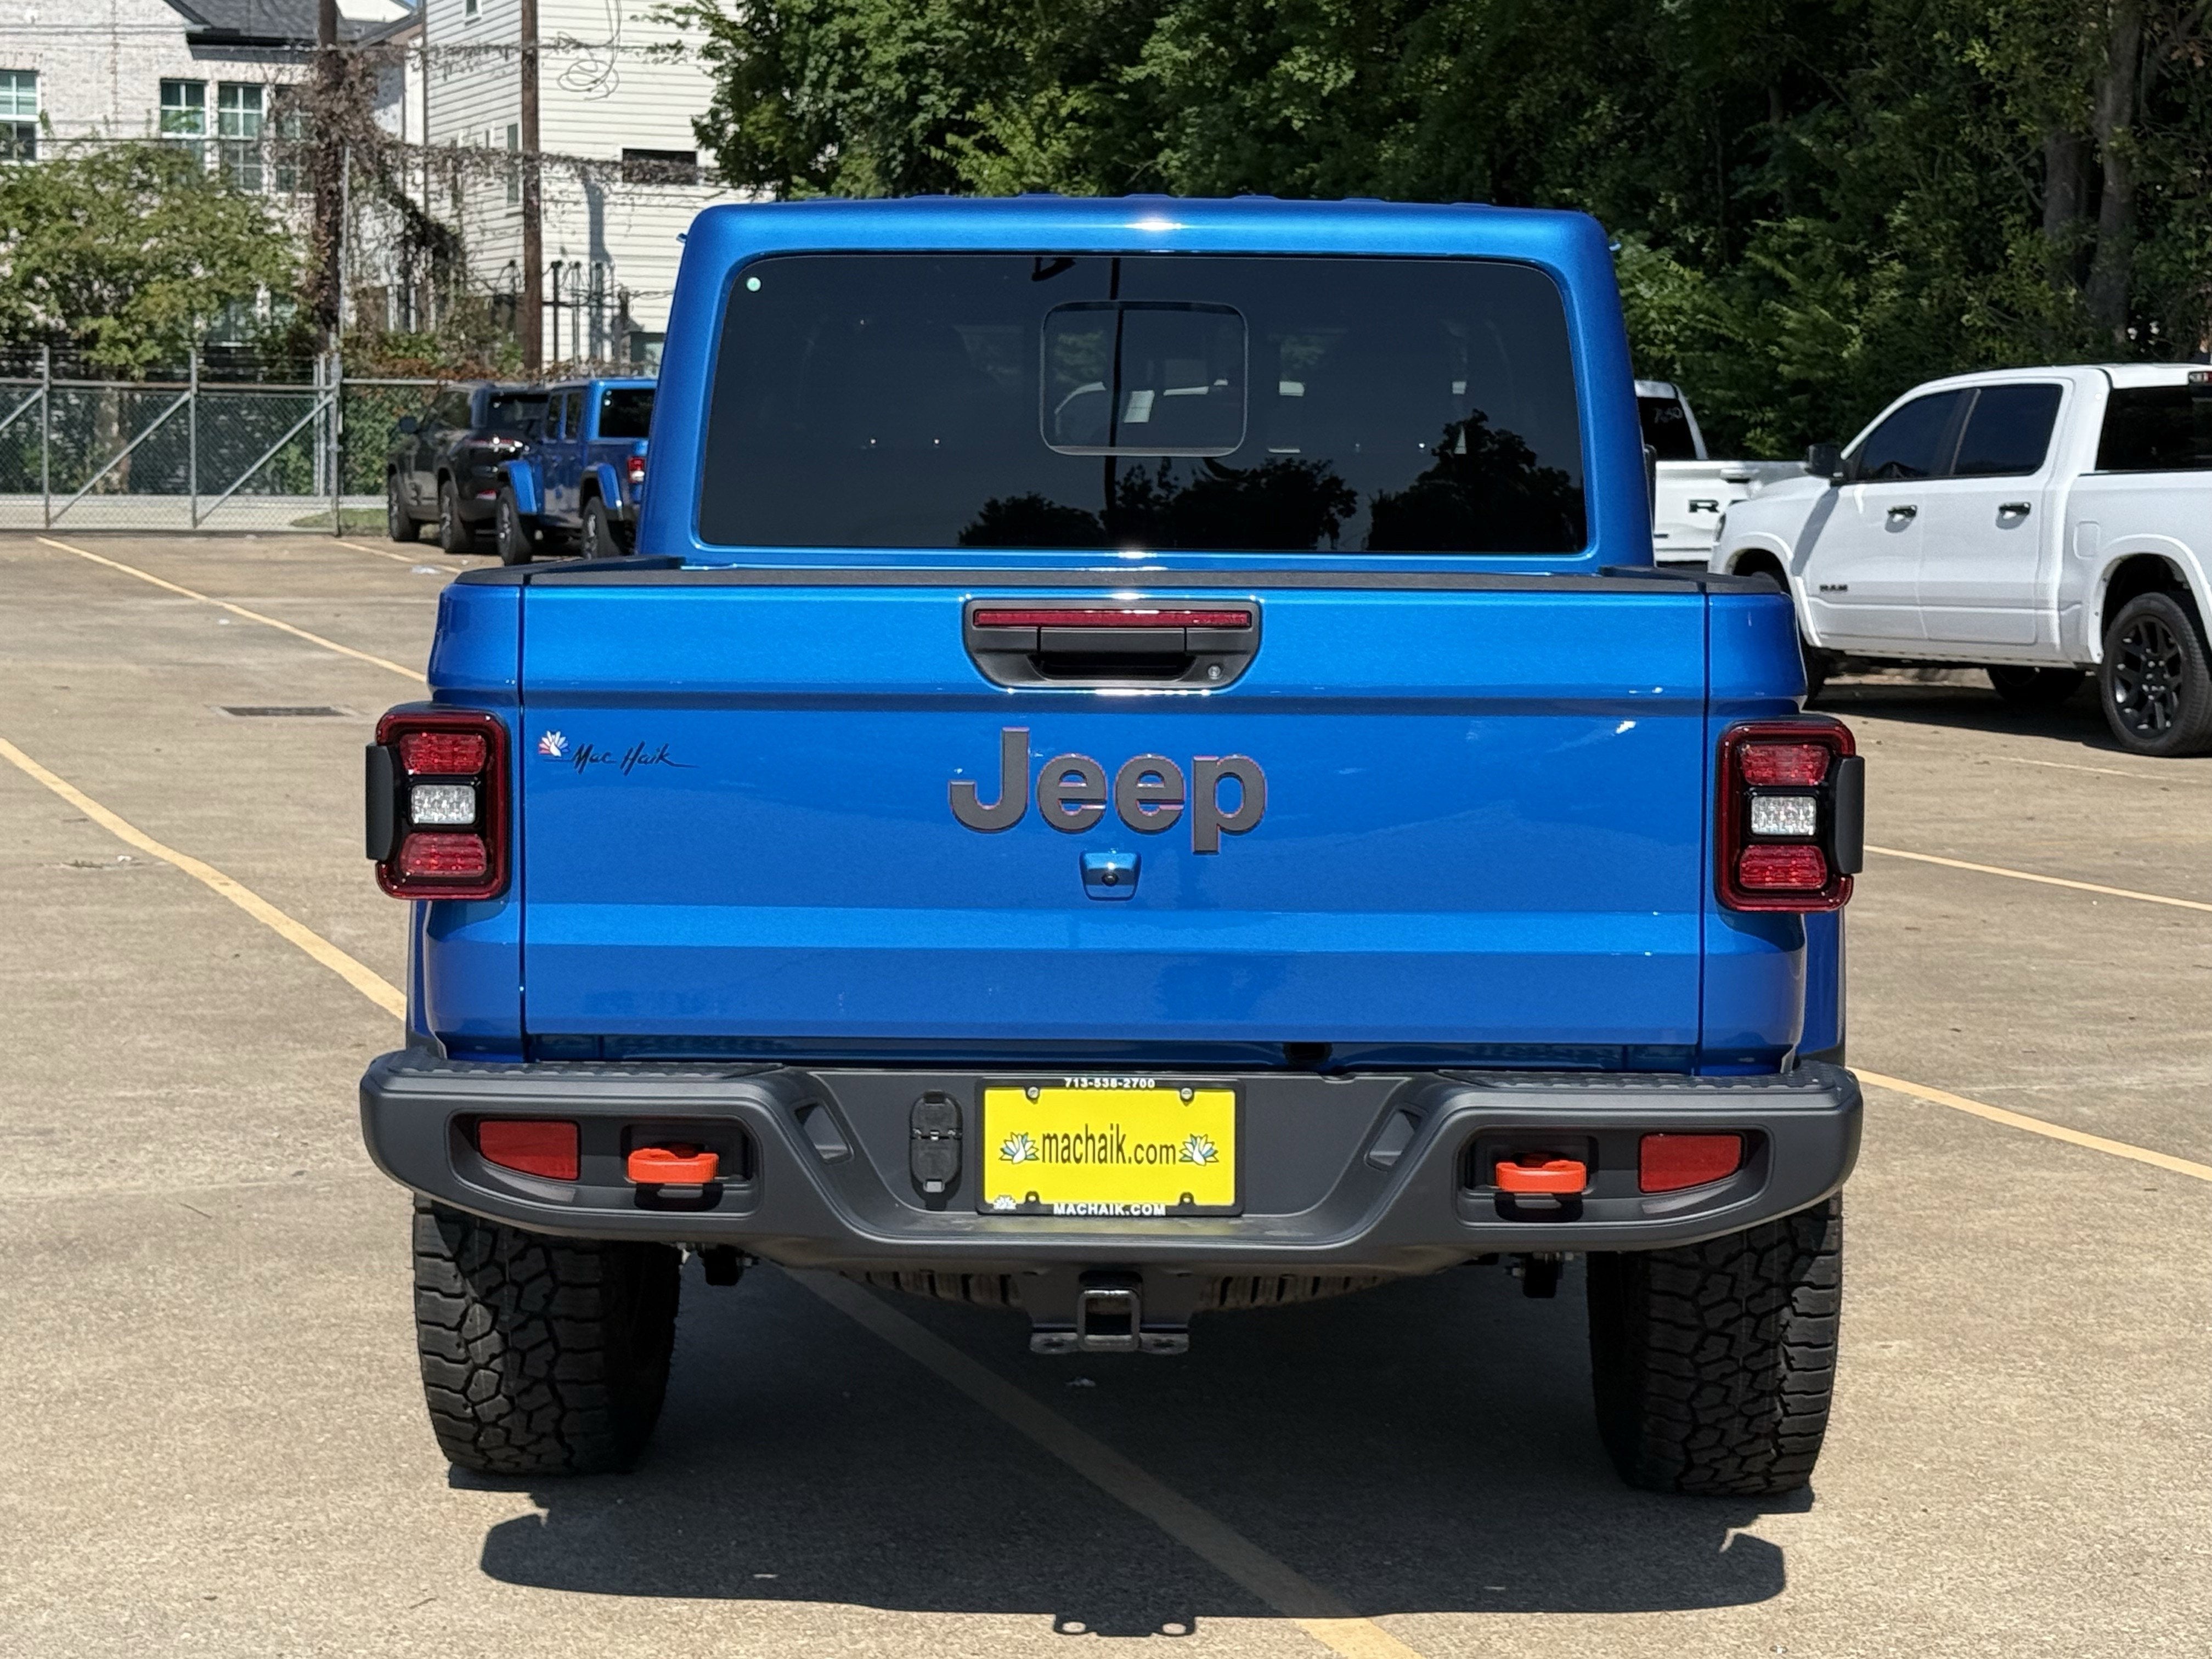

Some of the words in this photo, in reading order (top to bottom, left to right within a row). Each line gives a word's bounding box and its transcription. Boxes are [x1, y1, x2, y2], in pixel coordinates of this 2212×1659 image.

[544, 743, 617, 775] Mac
[619, 741, 701, 776] Haik
[949, 726, 1266, 855] Jeep
[1042, 1123, 1176, 1165] machaik.com
[1053, 1202, 1166, 1216] MACHAIK.COM
